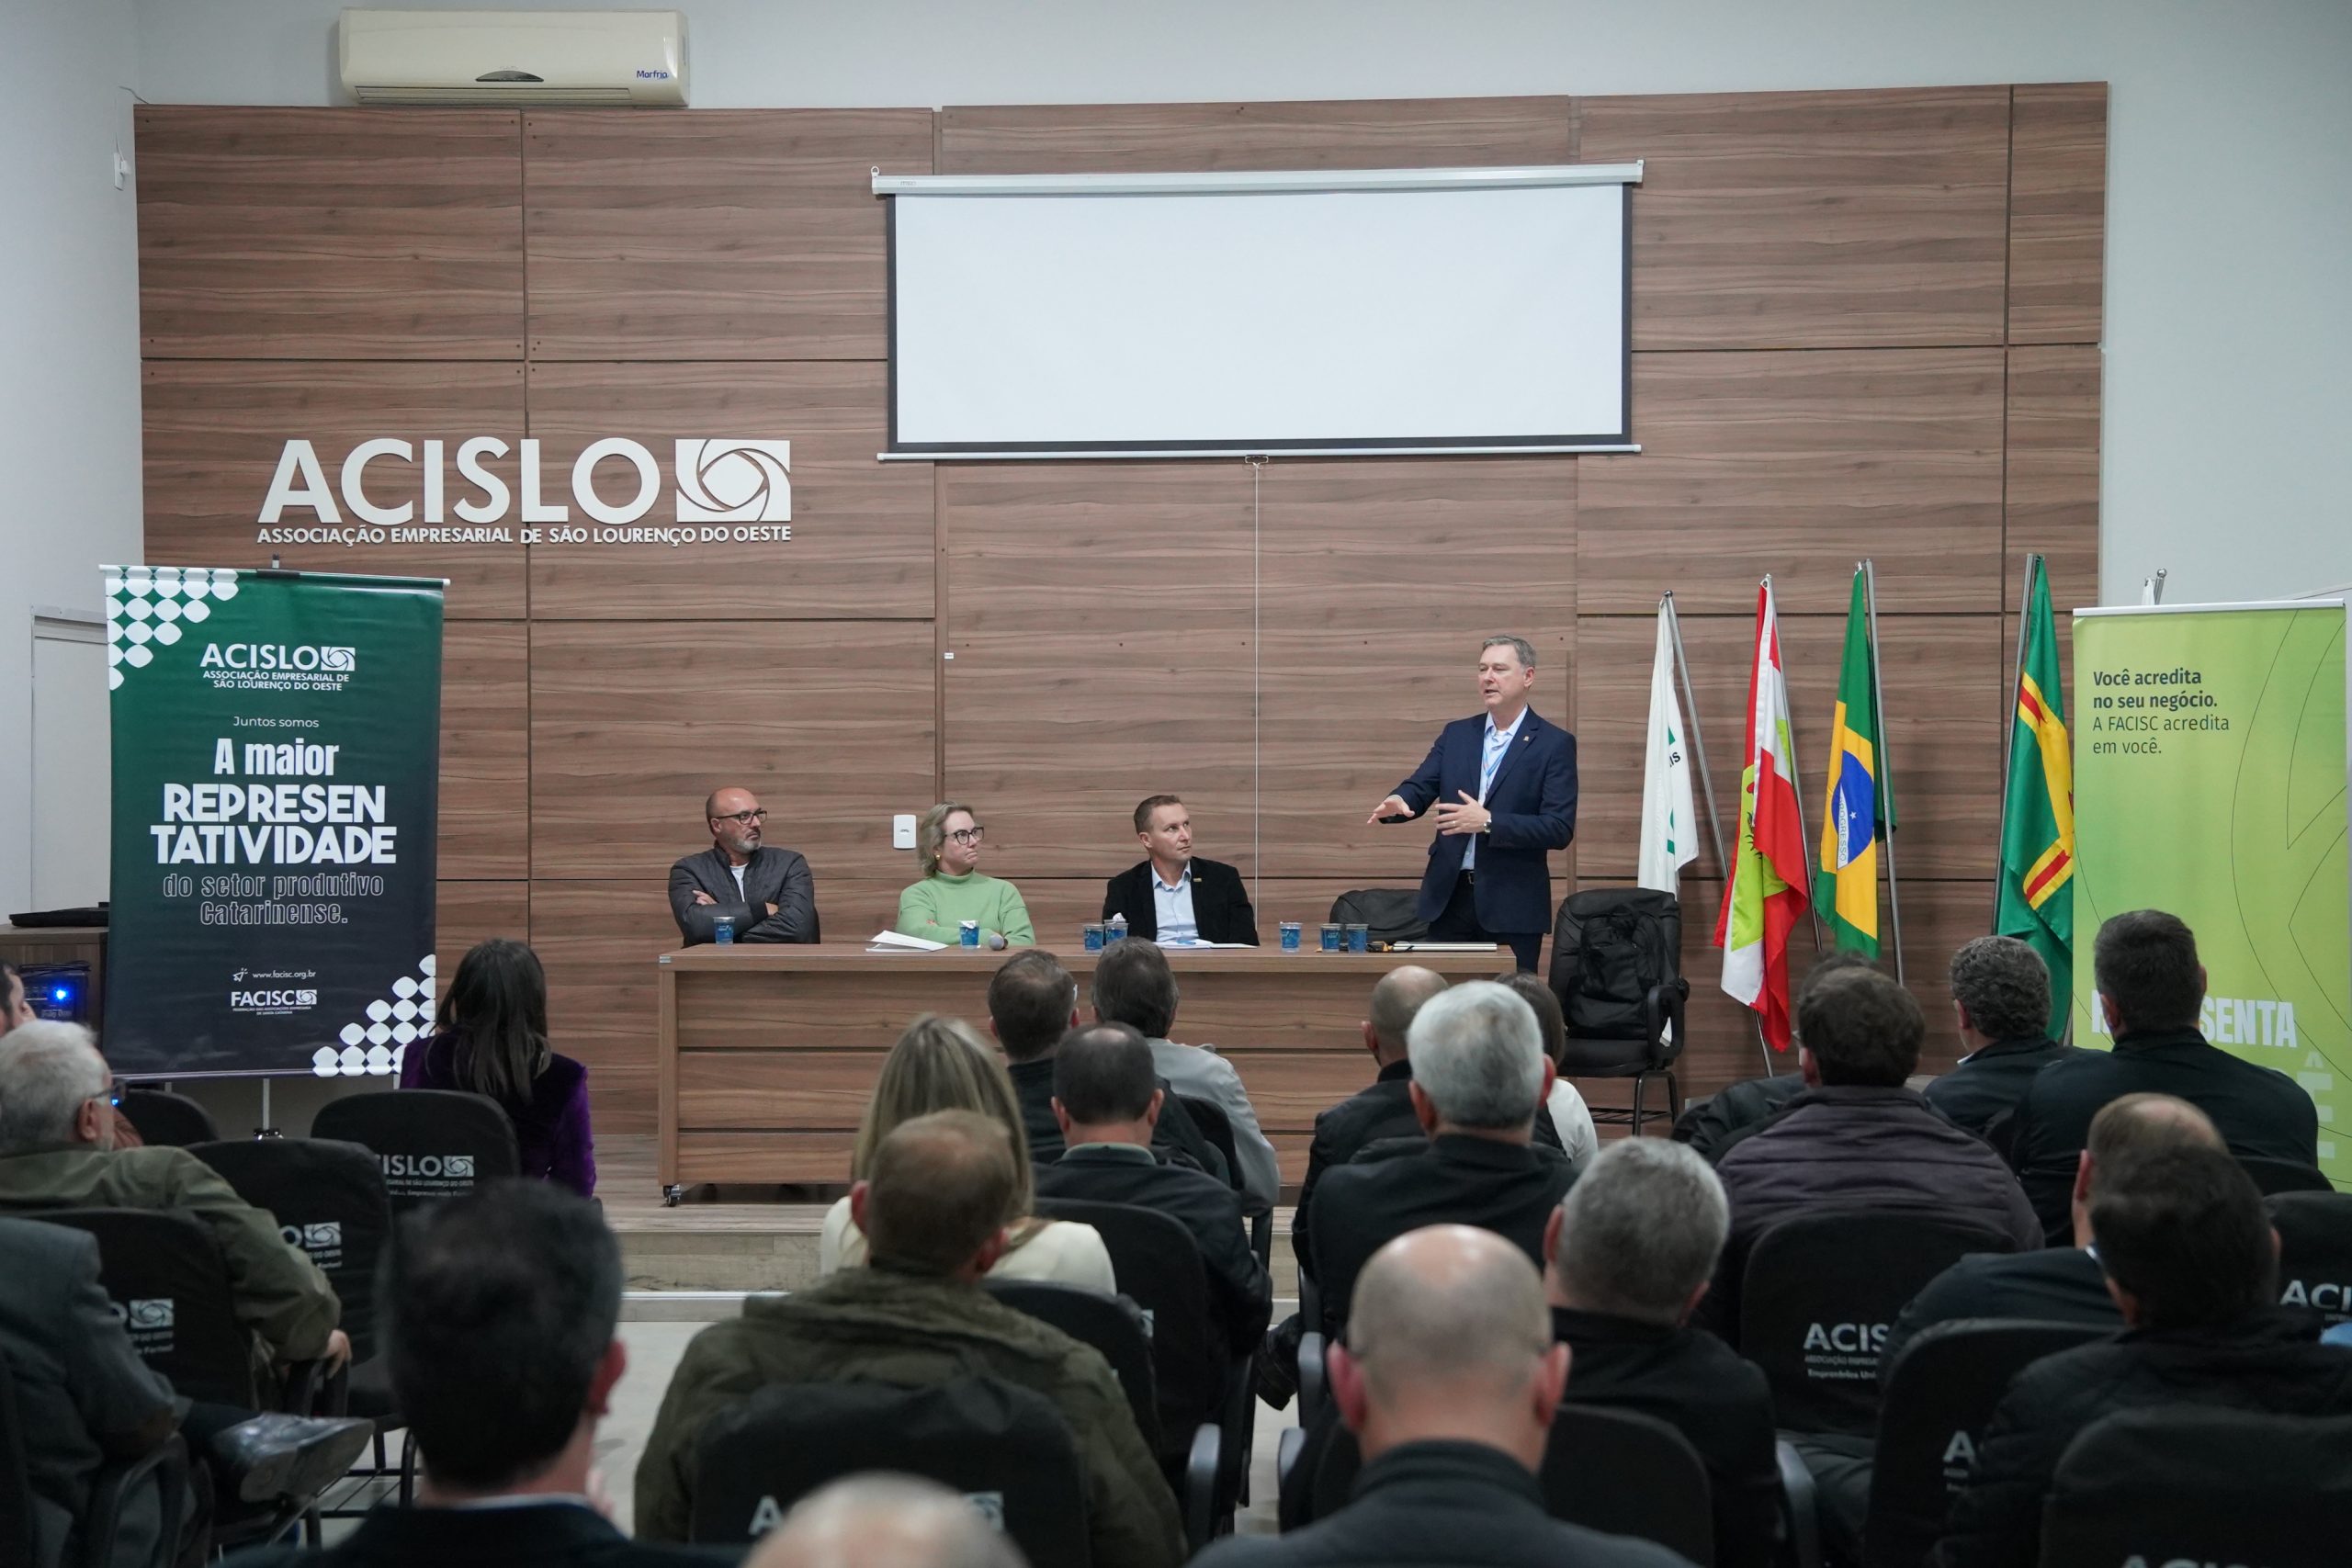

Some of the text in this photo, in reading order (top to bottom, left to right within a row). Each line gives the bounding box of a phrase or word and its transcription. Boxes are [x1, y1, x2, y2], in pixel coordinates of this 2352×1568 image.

[257, 436, 661, 525] ACISLO
[257, 525, 792, 547] ASSOCIAÇÃO EMPRESARIAL DE SÃO LOURENÇO DO OESTE
[199, 643, 320, 671] ACISLO
[203, 670, 269, 682] ASSOCIAÇÃO
[272, 672, 333, 682] EMPRESARIAL
[213, 679, 235, 688] SÃO
[237, 681, 291, 691] LOURENÇO
[312, 682, 343, 691] OESTE
[2093, 667, 2201, 686] Você acredita
[2093, 690, 2218, 712] no seu negócio.
[233, 716, 320, 728] Juntos somos
[2093, 714, 2229, 731] A FACISC acredita
[214, 738, 339, 775] A maior
[2093, 737, 2162, 754] em você.
[164, 784, 385, 823] REPRESEN
[150, 825, 397, 863] TATIVIDADE
[164, 872, 384, 899] do setor produtivo
[200, 900, 348, 924] Catarinense.
[253, 970, 316, 979] www.facisc.org.br
[231, 990, 295, 1007] FACISC
